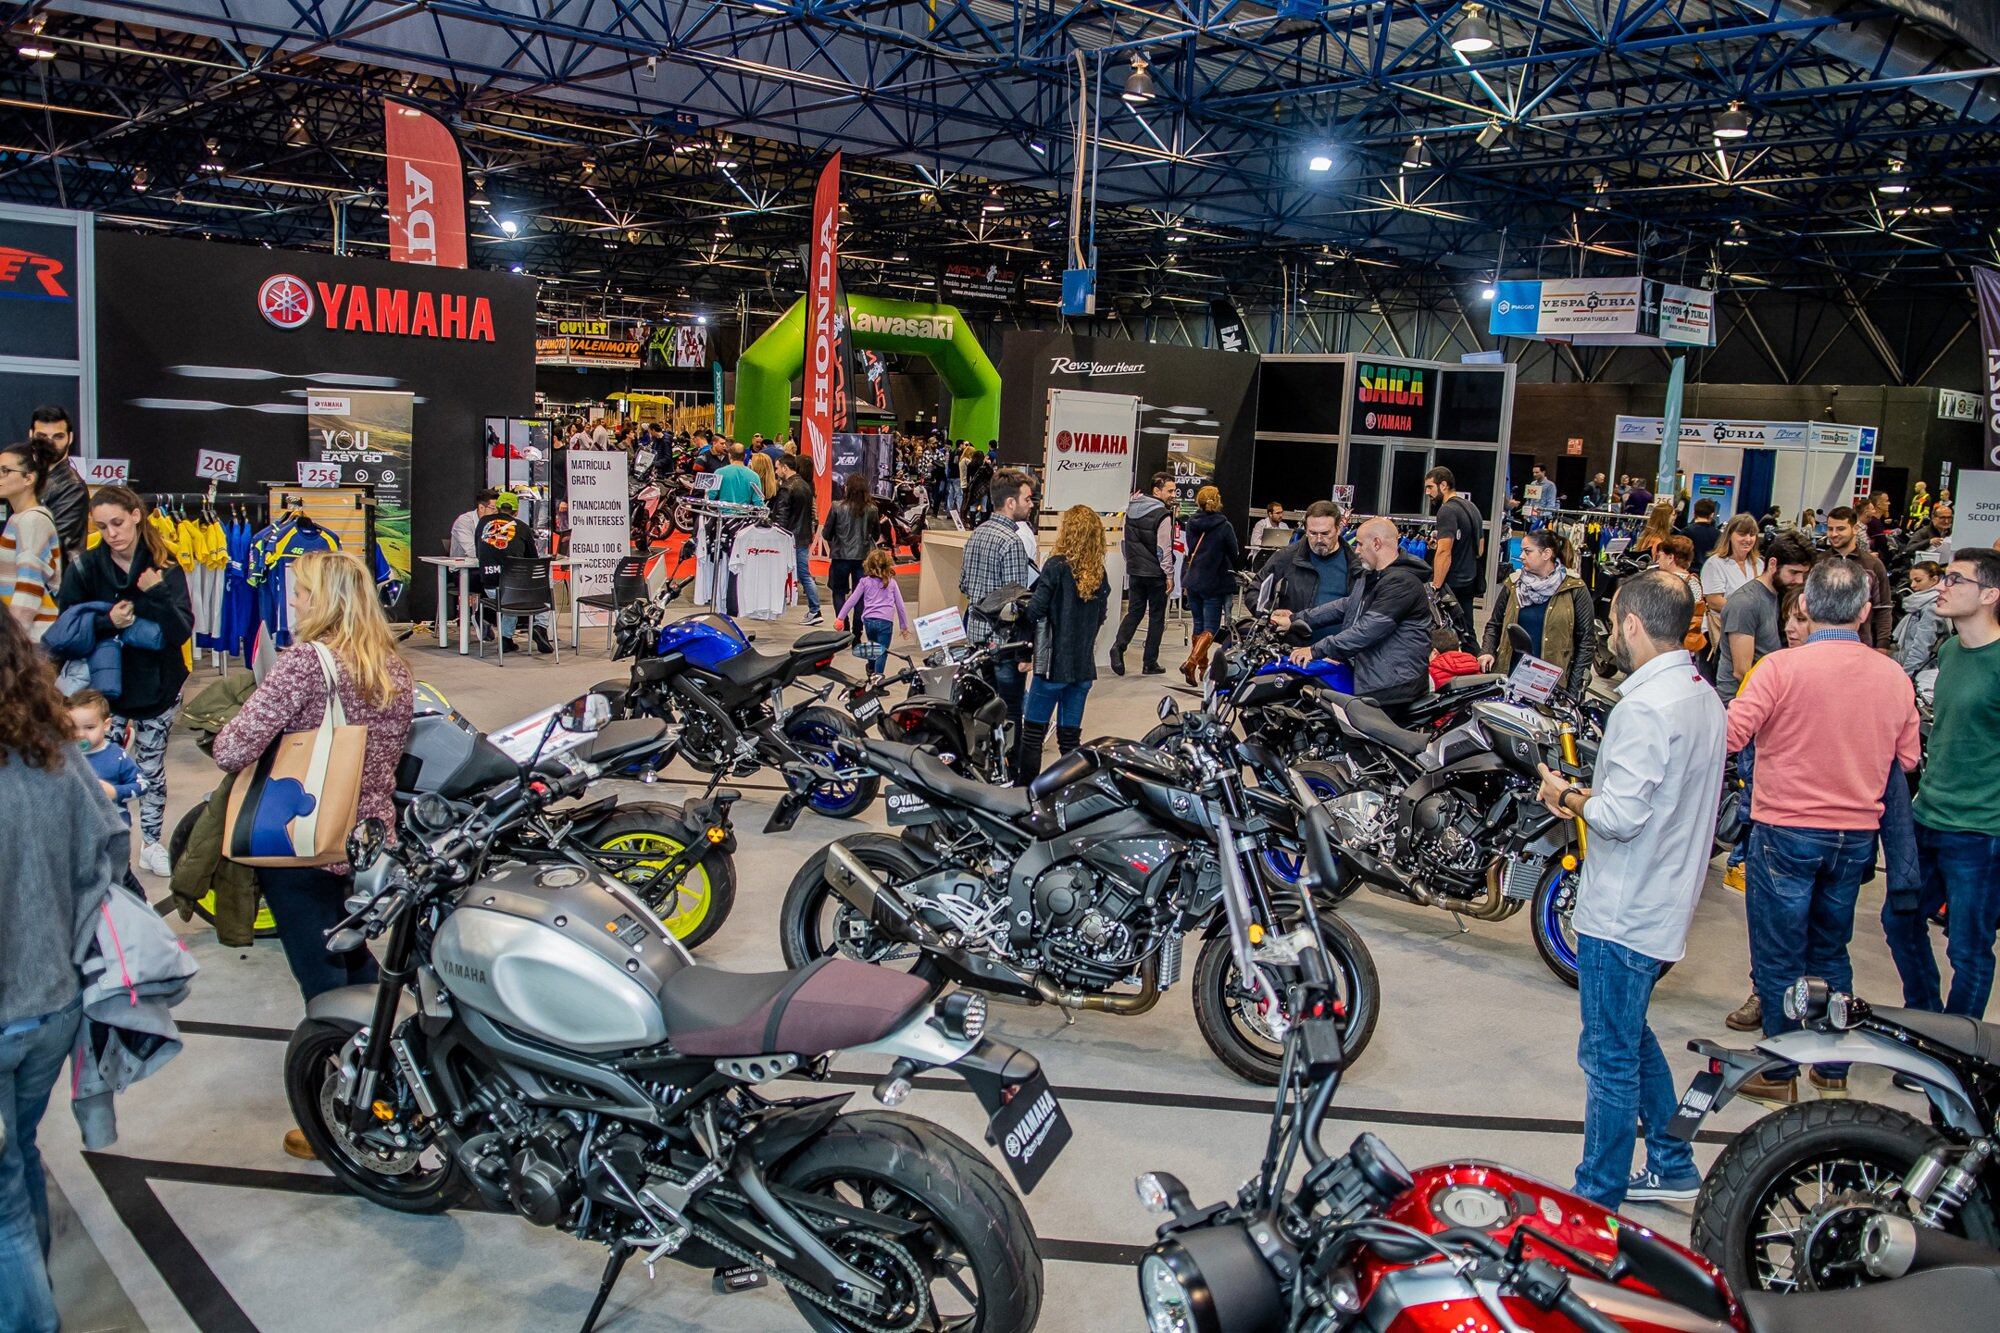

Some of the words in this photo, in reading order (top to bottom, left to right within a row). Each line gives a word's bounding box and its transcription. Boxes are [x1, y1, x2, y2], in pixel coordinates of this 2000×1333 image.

[1542, 299, 1585, 308] VESPA
[1662, 304, 1682, 315] MOTOS
[316, 281, 496, 342] YAMAHA
[814, 207, 833, 417] HONDA
[559, 320, 608, 335] OUTLET
[569, 338, 640, 354] VALENMOTO
[1050, 357, 1090, 375] Revs
[1089, 361, 1117, 377] Your
[1115, 361, 1145, 373] Heart
[1359, 364, 1423, 406] SAICA
[1376, 413, 1412, 431] YAMAHA
[322, 429, 369, 450] YOU
[1656, 427, 1702, 437] VSPA
[1714, 429, 1765, 439] TURIA
[1073, 432, 1128, 455] YAMAHA
[321, 453, 360, 463] EASY
[362, 455, 383, 463] GO
[571, 459, 612, 470] MATRÍCULA
[91, 464, 126, 479] 40€
[203, 456, 236, 475] 20€
[1057, 459, 1084, 472] Revs
[1083, 460, 1102, 472] Your
[1101, 461, 1122, 469] Heart
[308, 469, 339, 482] 25€
[571, 475, 597, 486] GRATIS
[572, 499, 622, 511] FINANCIACIÓN
[572, 515, 585, 526] 0%
[291, 547, 305, 555] 46
[572, 543, 600, 553] REGALO
[602, 543, 616, 553] 100
[617, 543, 622, 553] €
[594, 573, 608, 584] 125
[899, 793, 924, 806] YAM
[442, 960, 487, 984] YAMAHA
[1013, 1089, 1057, 1145] YAMAHA
